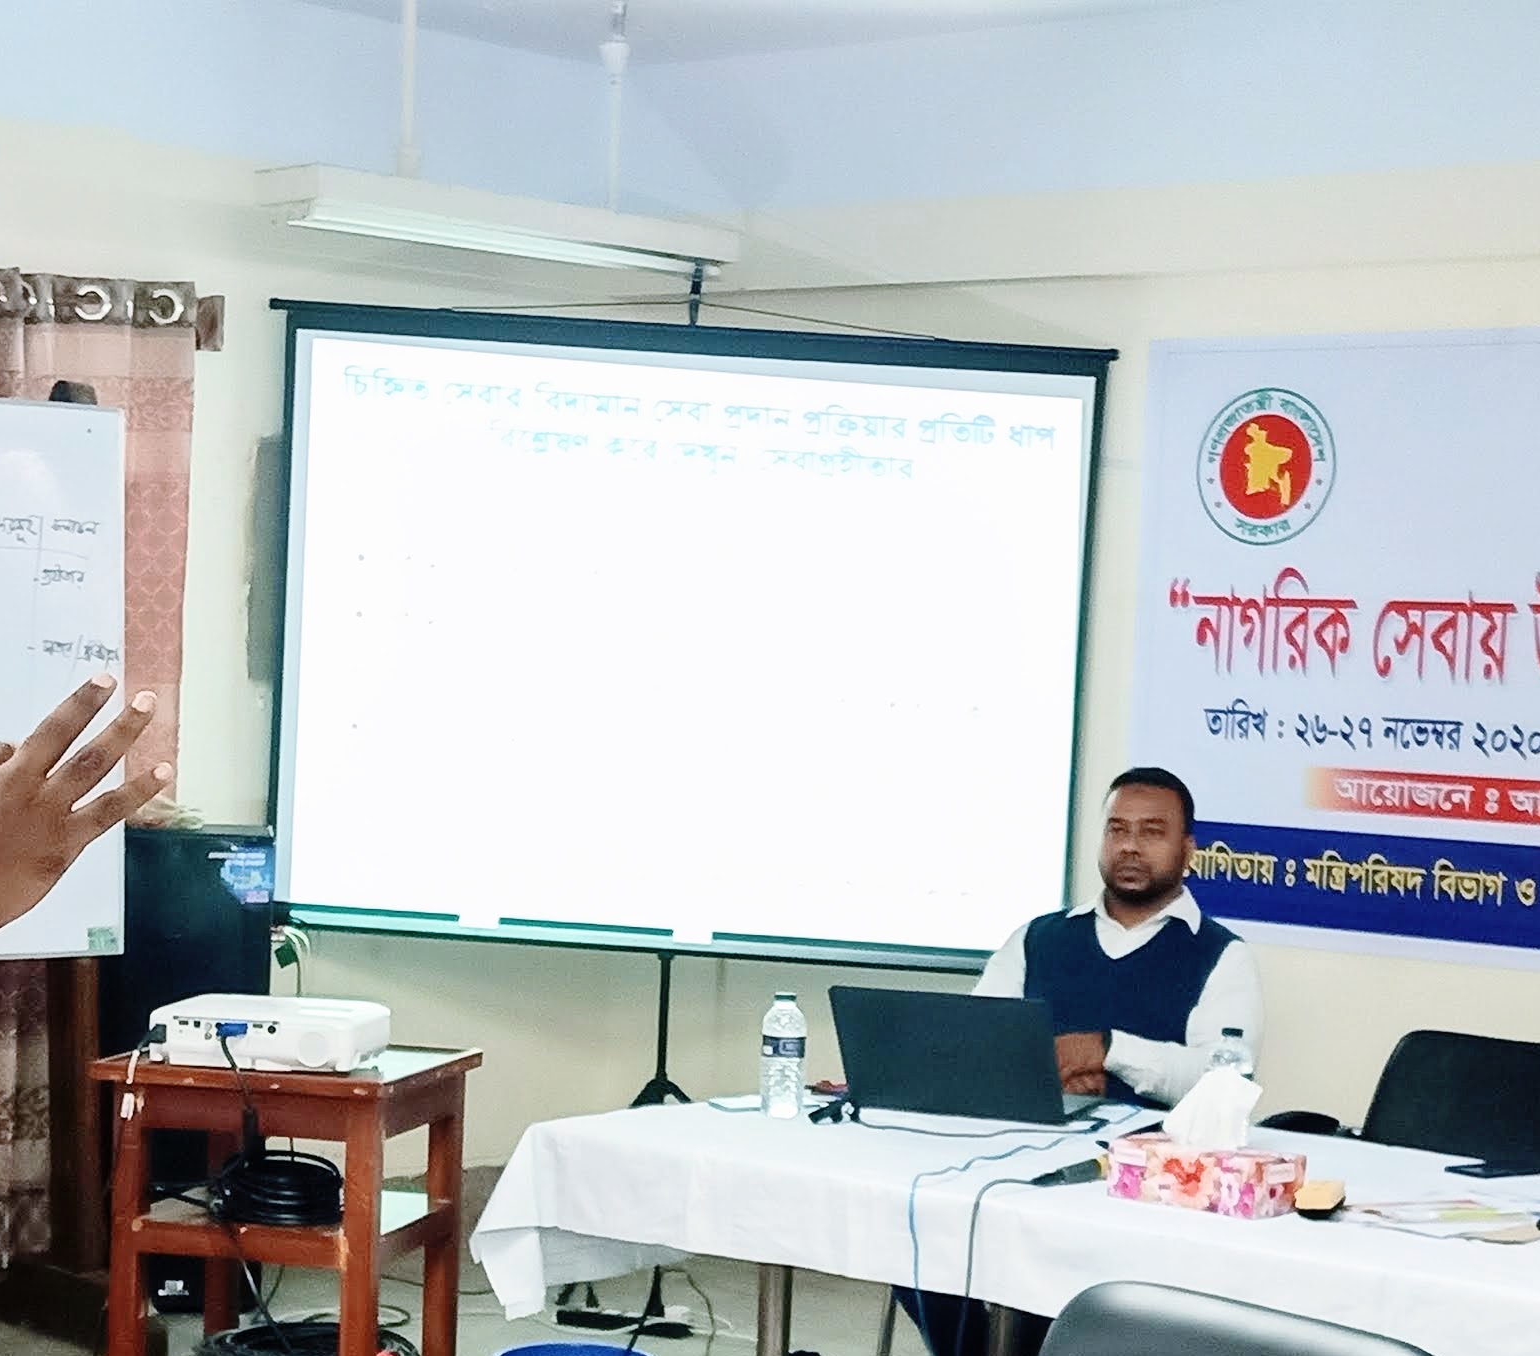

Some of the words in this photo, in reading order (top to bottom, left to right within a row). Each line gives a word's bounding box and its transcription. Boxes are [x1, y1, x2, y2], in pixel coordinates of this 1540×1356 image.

[918, 412, 997, 445] প্রতিটি
[1008, 424, 1057, 452] ধাপ
[1168, 567, 1359, 678] “নাগরিক
[1372, 590, 1516, 687] সেবায়
[1205, 699, 1266, 744] তারিখ
[1295, 714, 1372, 750] ২৬-২৭
[1383, 719, 1464, 753] নভেম্বর
[1334, 775, 1473, 811] আয়োজনে
[1433, 862, 1504, 907] বিভাগ
